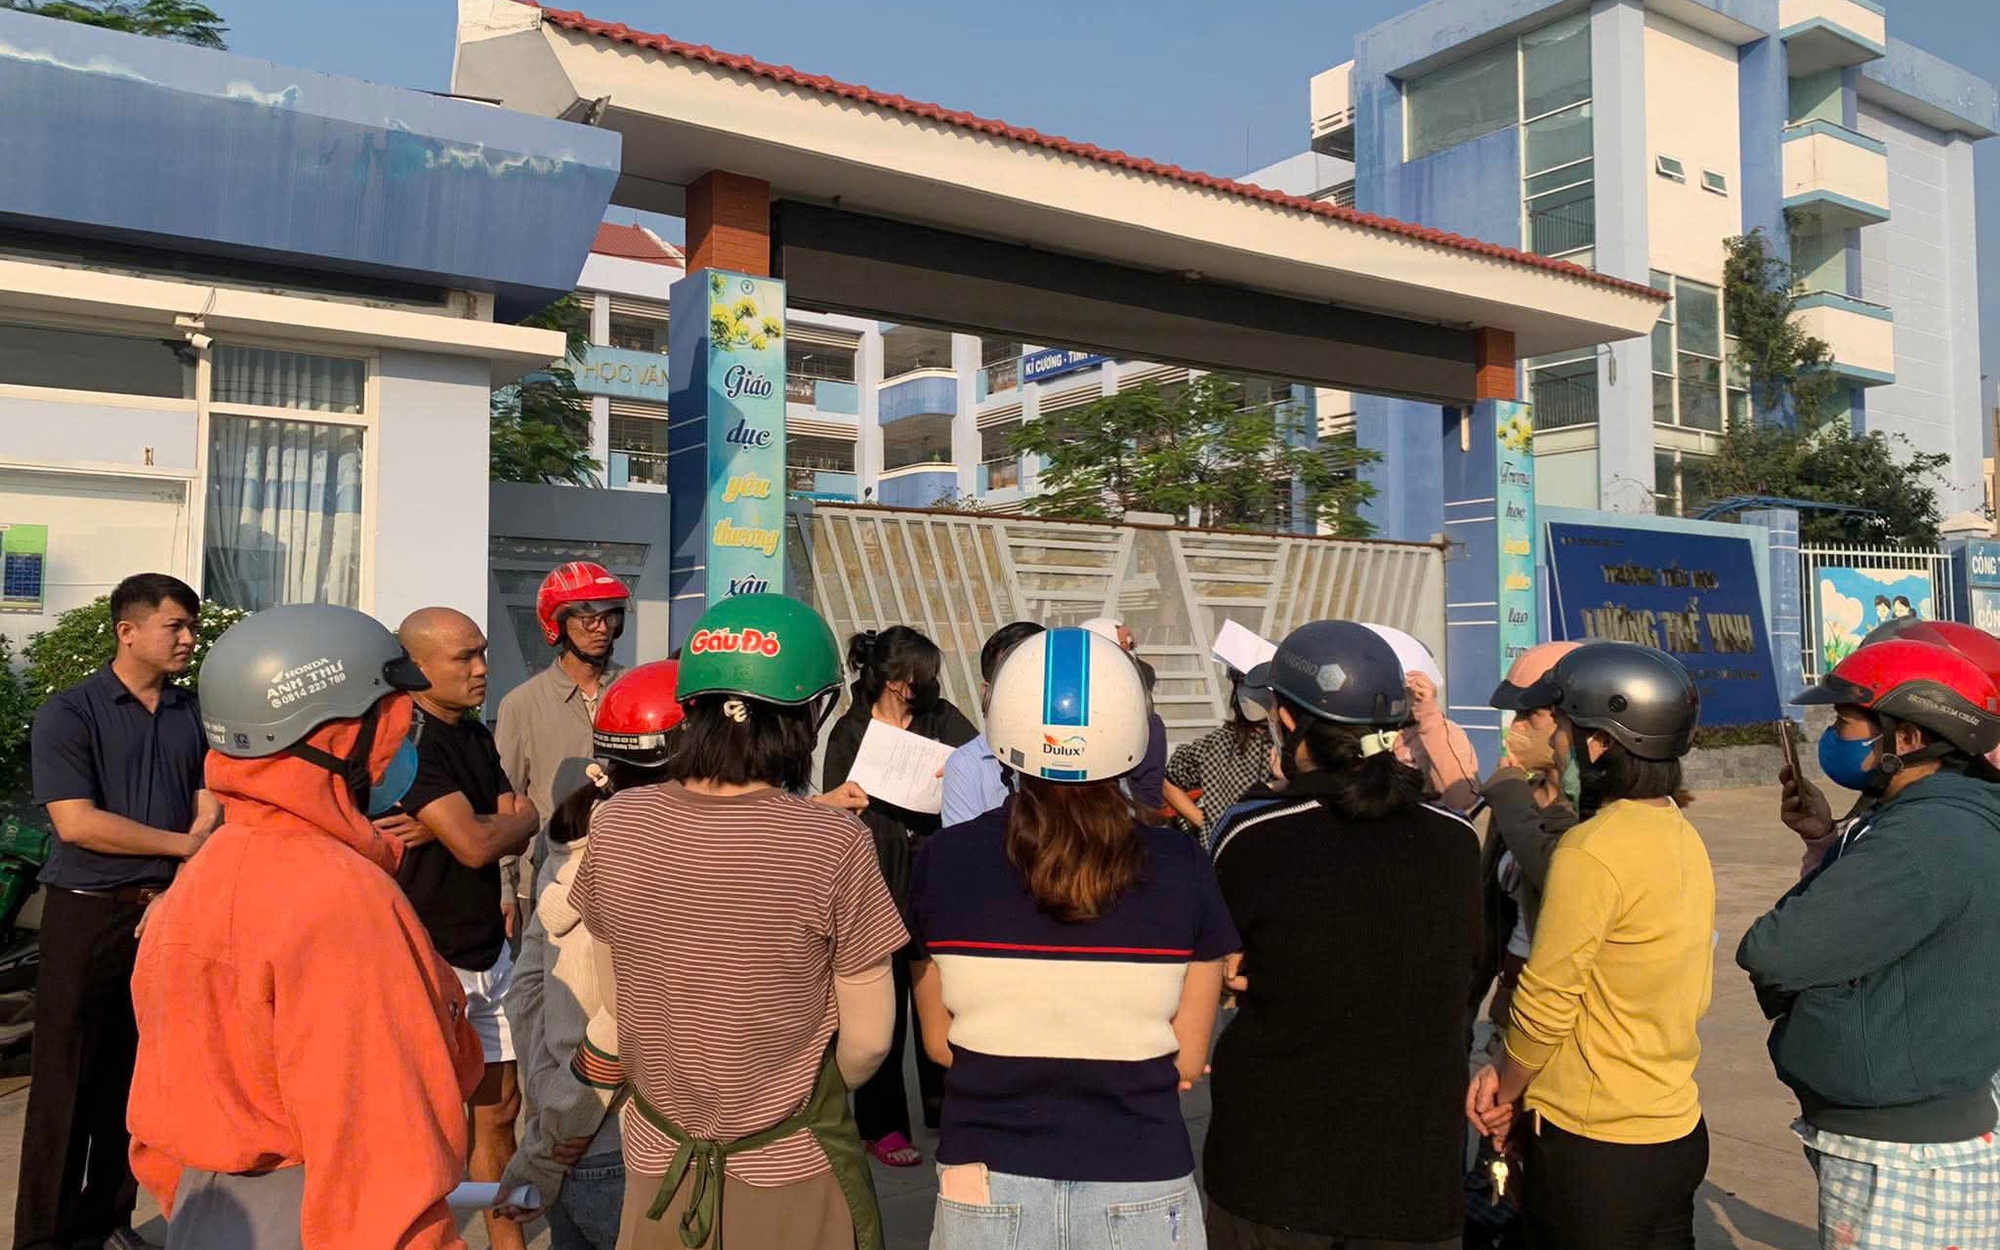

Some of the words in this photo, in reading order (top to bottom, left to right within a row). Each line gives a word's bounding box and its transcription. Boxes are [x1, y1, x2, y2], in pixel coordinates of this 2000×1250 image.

[583, 360, 632, 384] HỌC
[724, 365, 773, 399] Giáo
[725, 419, 771, 450] dục
[722, 472, 770, 502] yêu
[1972, 546, 1997, 575] CỔNG
[690, 627, 740, 655] Gấu
[740, 628, 780, 657] Đỏ
[267, 678, 303, 700] ANH
[306, 659, 344, 682] THƯ
[284, 658, 329, 679] HONDA
[281, 687, 307, 704] 0814
[308, 680, 327, 694] 223
[328, 672, 346, 687] 789
[1043, 743, 1080, 756] Dulux
